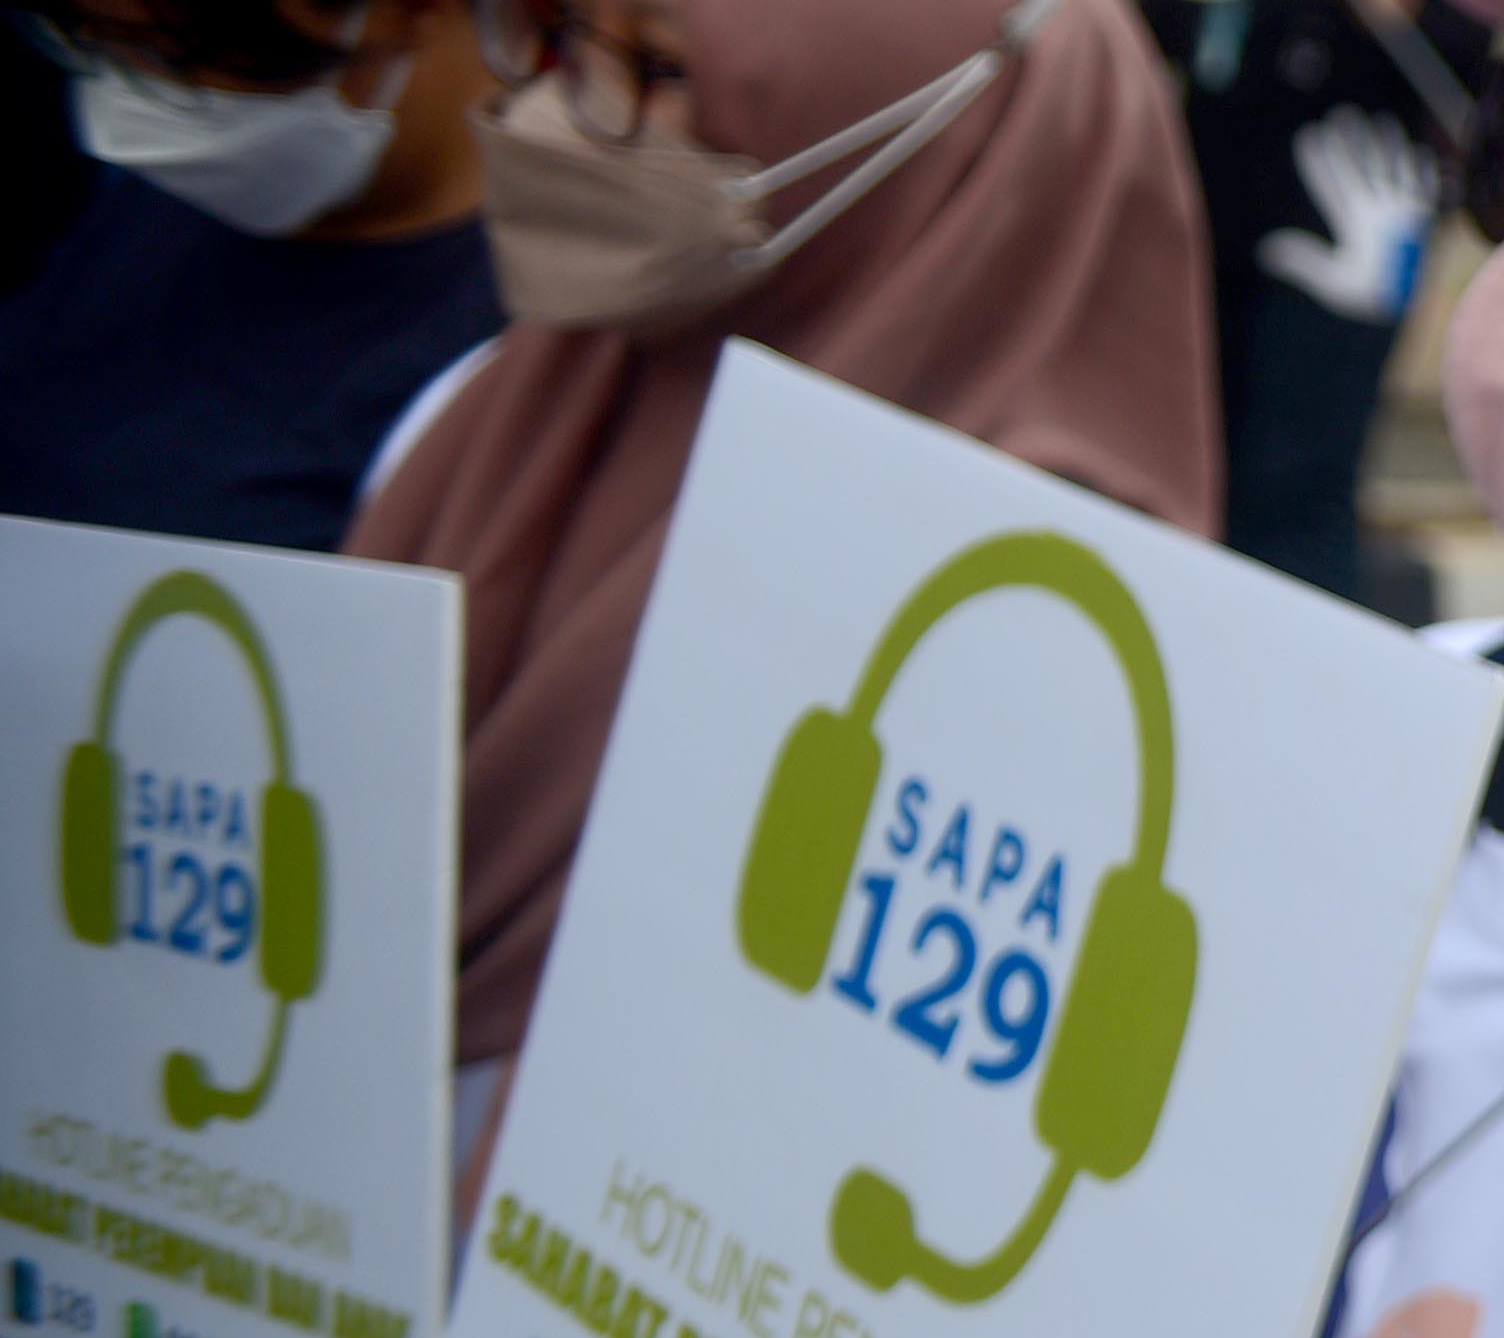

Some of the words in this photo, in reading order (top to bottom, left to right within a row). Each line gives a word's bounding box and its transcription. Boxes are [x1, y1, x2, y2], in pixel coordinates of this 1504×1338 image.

[133, 770, 250, 845] SAPA
[888, 775, 1066, 943] SAPA
[118, 841, 256, 966] 129
[831, 871, 1052, 1085] 129
